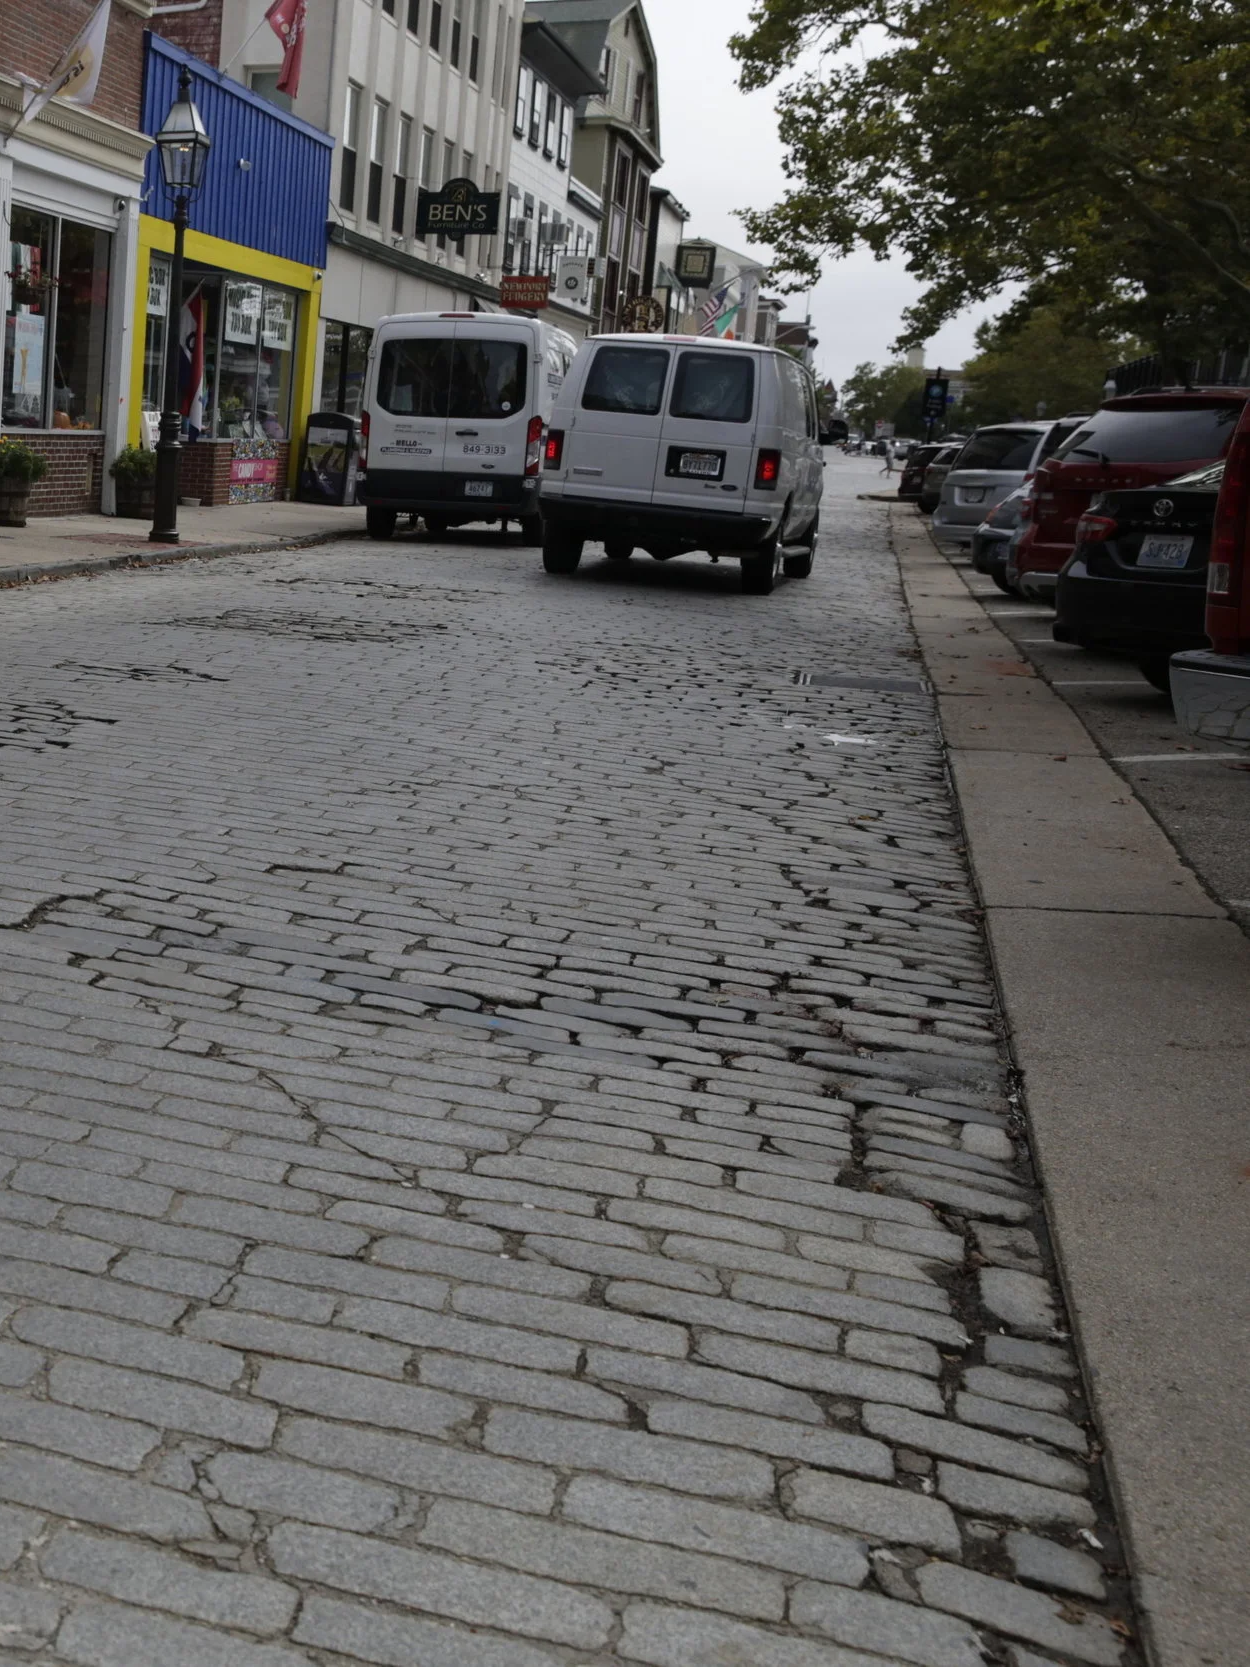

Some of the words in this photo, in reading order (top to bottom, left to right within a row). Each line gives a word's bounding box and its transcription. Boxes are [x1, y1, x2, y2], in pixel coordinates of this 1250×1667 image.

[429, 203, 487, 221] BEN'S
[502, 281, 547, 291] NEWPORT
[502, 291, 546, 302] FUDGERY
